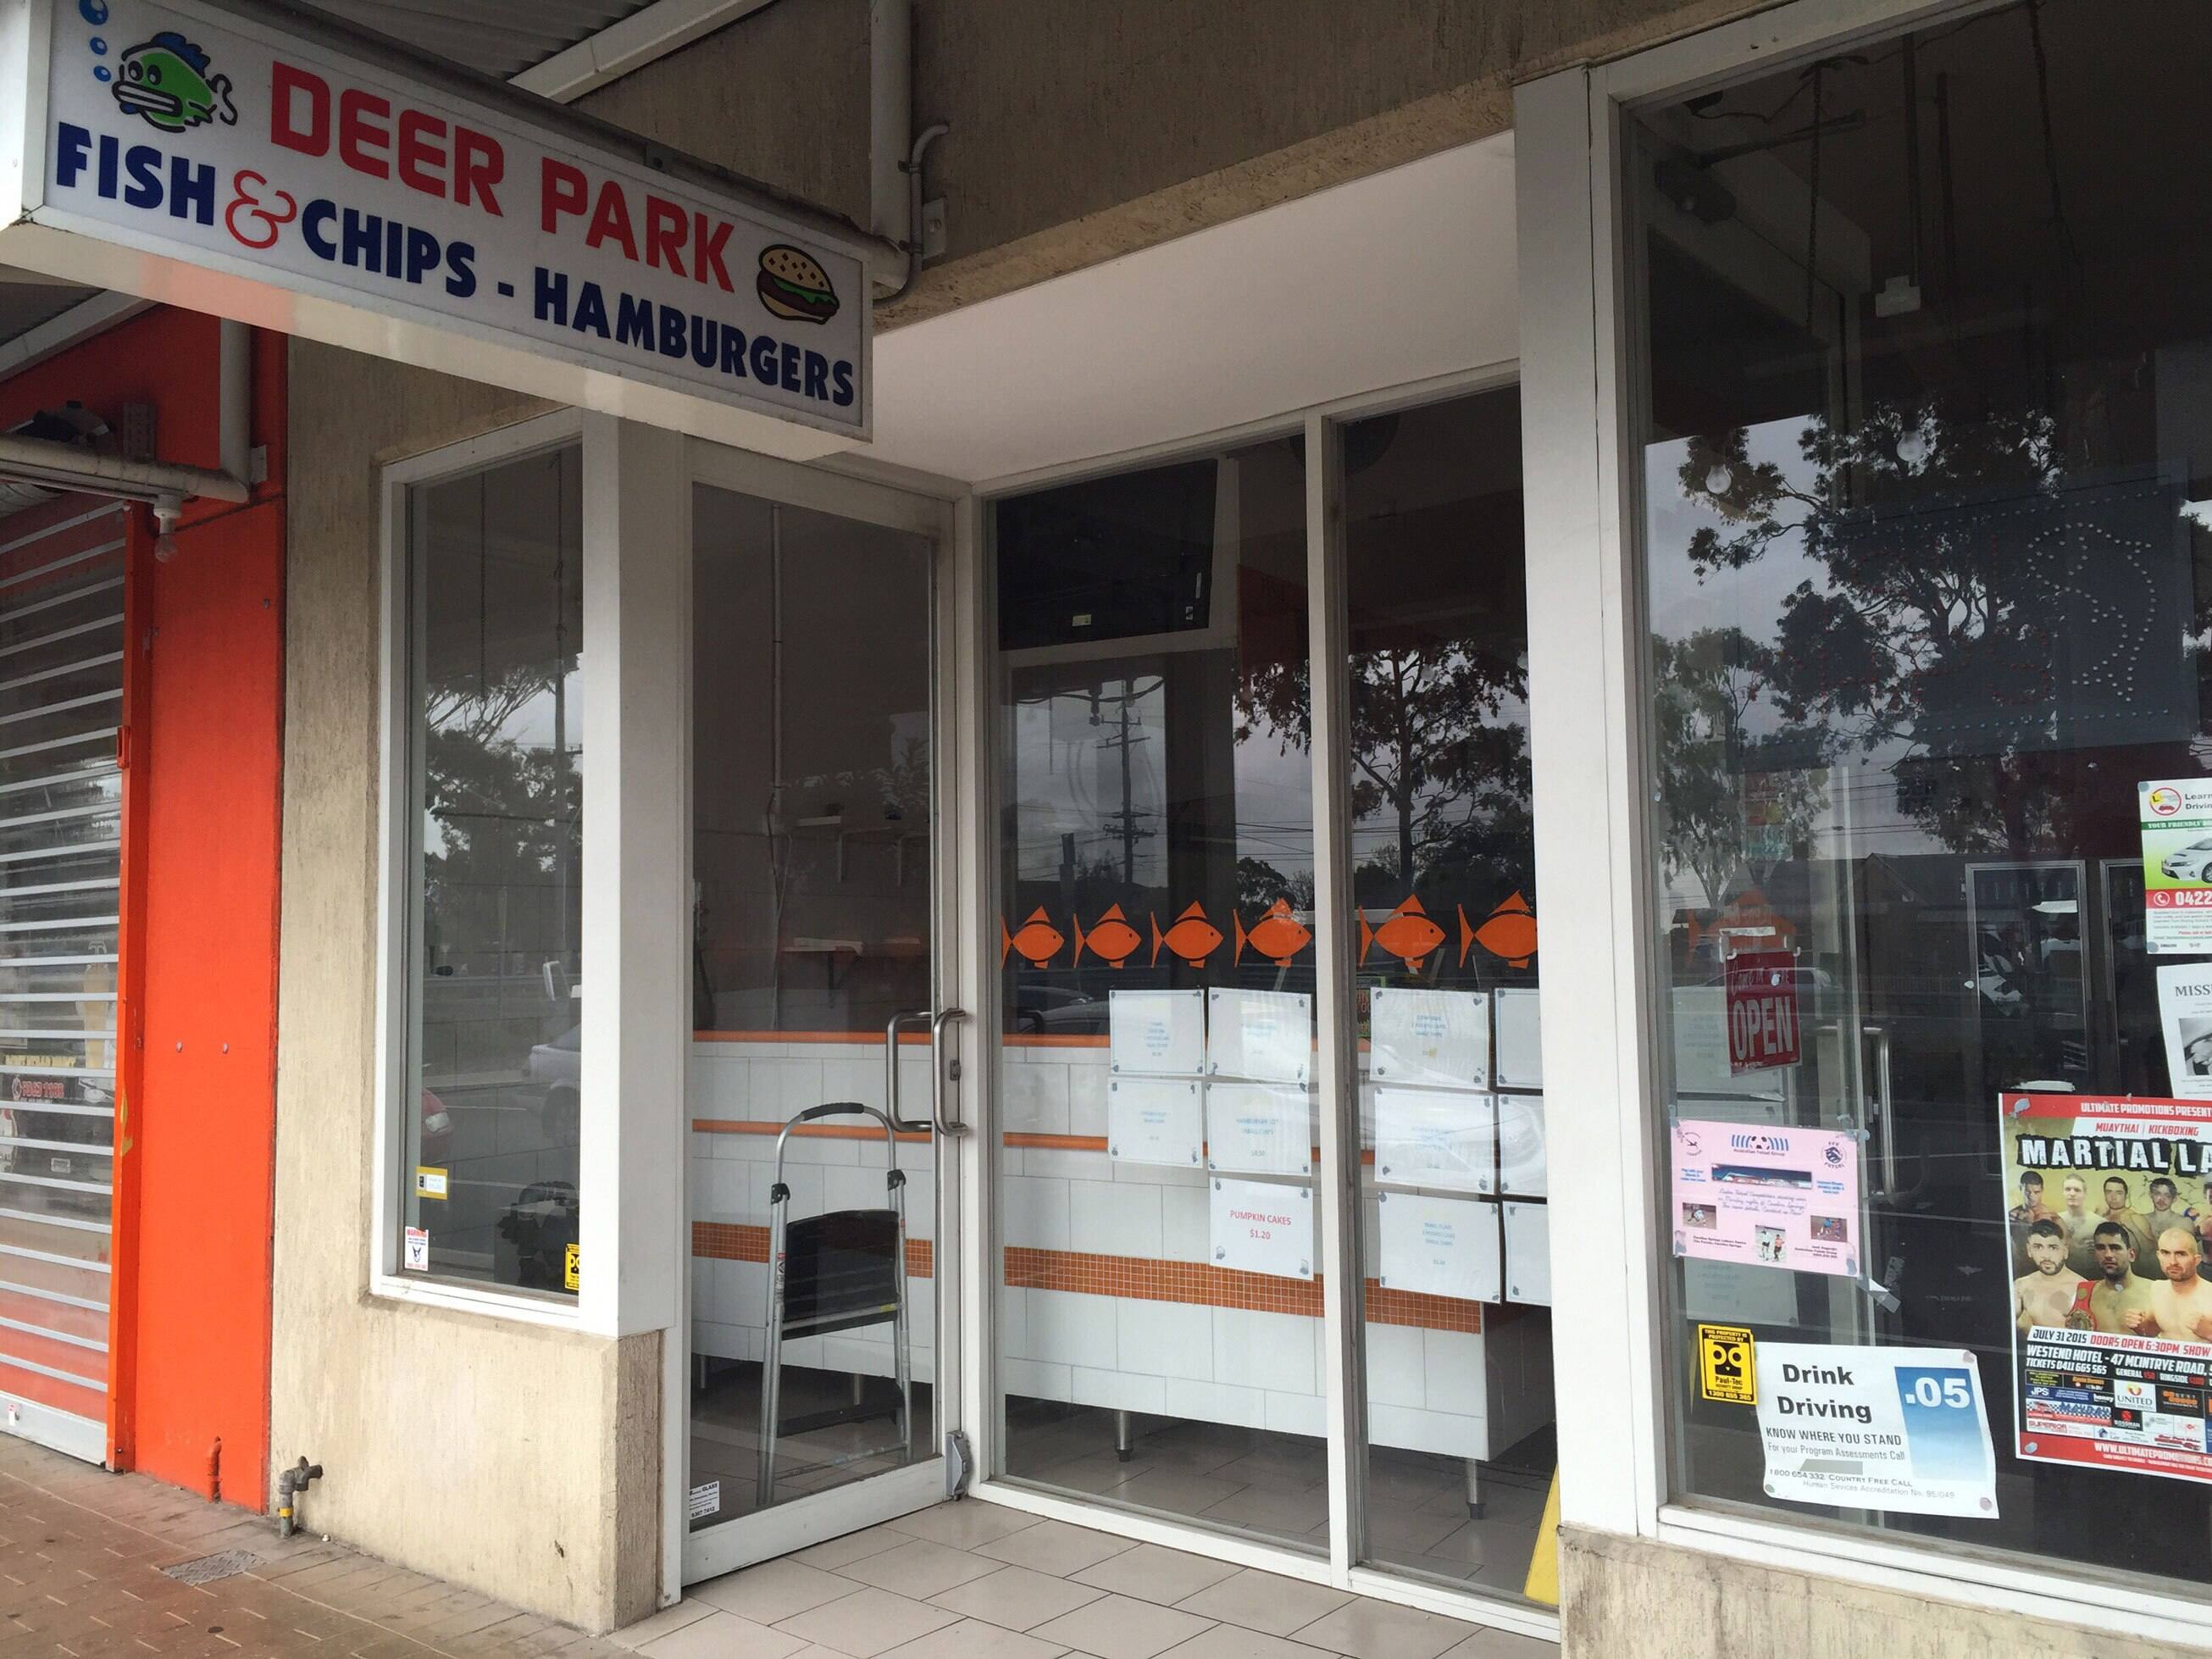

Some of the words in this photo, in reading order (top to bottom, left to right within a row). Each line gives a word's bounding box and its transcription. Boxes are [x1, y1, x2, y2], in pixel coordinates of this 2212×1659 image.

[270, 60, 504, 217] DEER
[541, 157, 735, 293] PARK
[56, 121, 216, 226] FISH
[225, 169, 297, 249] &
[301, 198, 477, 297] CHIPS
[496, 281, 515, 297] -
[534, 266, 855, 407] HAMBURGERS
[2175, 891, 2212, 906] 0422
[2175, 985, 2212, 997] MISS
[1732, 996, 1793, 1060] OPEN
[2081, 1102, 2120, 1113] ULTIMATE
[2121, 1104, 2175, 1115] PROMOTIONS
[2095, 1123, 2139, 1134] MUAYTHAI
[2148, 1124, 2200, 1136] KICKBOXING
[2021, 1139, 2169, 1168] MARTIAL
[2178, 1143, 2212, 1174] LA
[1229, 1209, 1266, 1223] PUMPKIN
[1267, 1214, 1292, 1226] CAKES
[1250, 1228, 1271, 1240] $1.20
[2033, 1329, 2054, 1340] JULY
[2056, 1331, 2065, 1341] 31
[2066, 1332, 2087, 1344] 2015
[2090, 1334, 2119, 1347] DOORS
[2121, 1339, 2145, 1349] OPEN
[2146, 1340, 2181, 1353] 6:30PM
[2182, 1345, 2211, 1357] SHOW
[2026, 1345, 2072, 1360] WESTEND
[2072, 1349, 2103, 1363] HOTEL
[2110, 1354, 2125, 1366] 47
[1782, 1363, 1854, 1386] Drink
[2026, 1357, 2056, 1369] TICKETS
[2057, 1360, 2075, 1371] 0411
[2076, 1362, 2091, 1373] 665
[2092, 1364, 2108, 1375] 565
[2115, 1368, 2143, 1379] GENERAL
[1715, 1376, 1743, 1386] Paul-Tec
[1904, 1377, 1971, 1409] .05
[2031, 1386, 2049, 1396] JPS
[2117, 1395, 2153, 1405] UNITED
[1777, 1395, 1872, 1424] Driving
[1766, 1427, 1796, 1440] KNOW
[1799, 1429, 1836, 1442] WHERE
[1838, 1433, 1860, 1444] YOU
[1864, 1434, 1902, 1445] STAND
[1768, 1442, 1779, 1451] For
[1782, 1445, 1798, 1455] your
[1800, 1445, 1833, 1457] Program
[1836, 1447, 1888, 1460] Assessments
[1890, 1451, 1905, 1461] Call
[1803, 1479, 1828, 1489] Human
[1860, 1485, 1909, 1496] Accreditation
[1868, 1477, 1888, 1485] FREE
[1891, 1479, 1913, 1487] CALL
